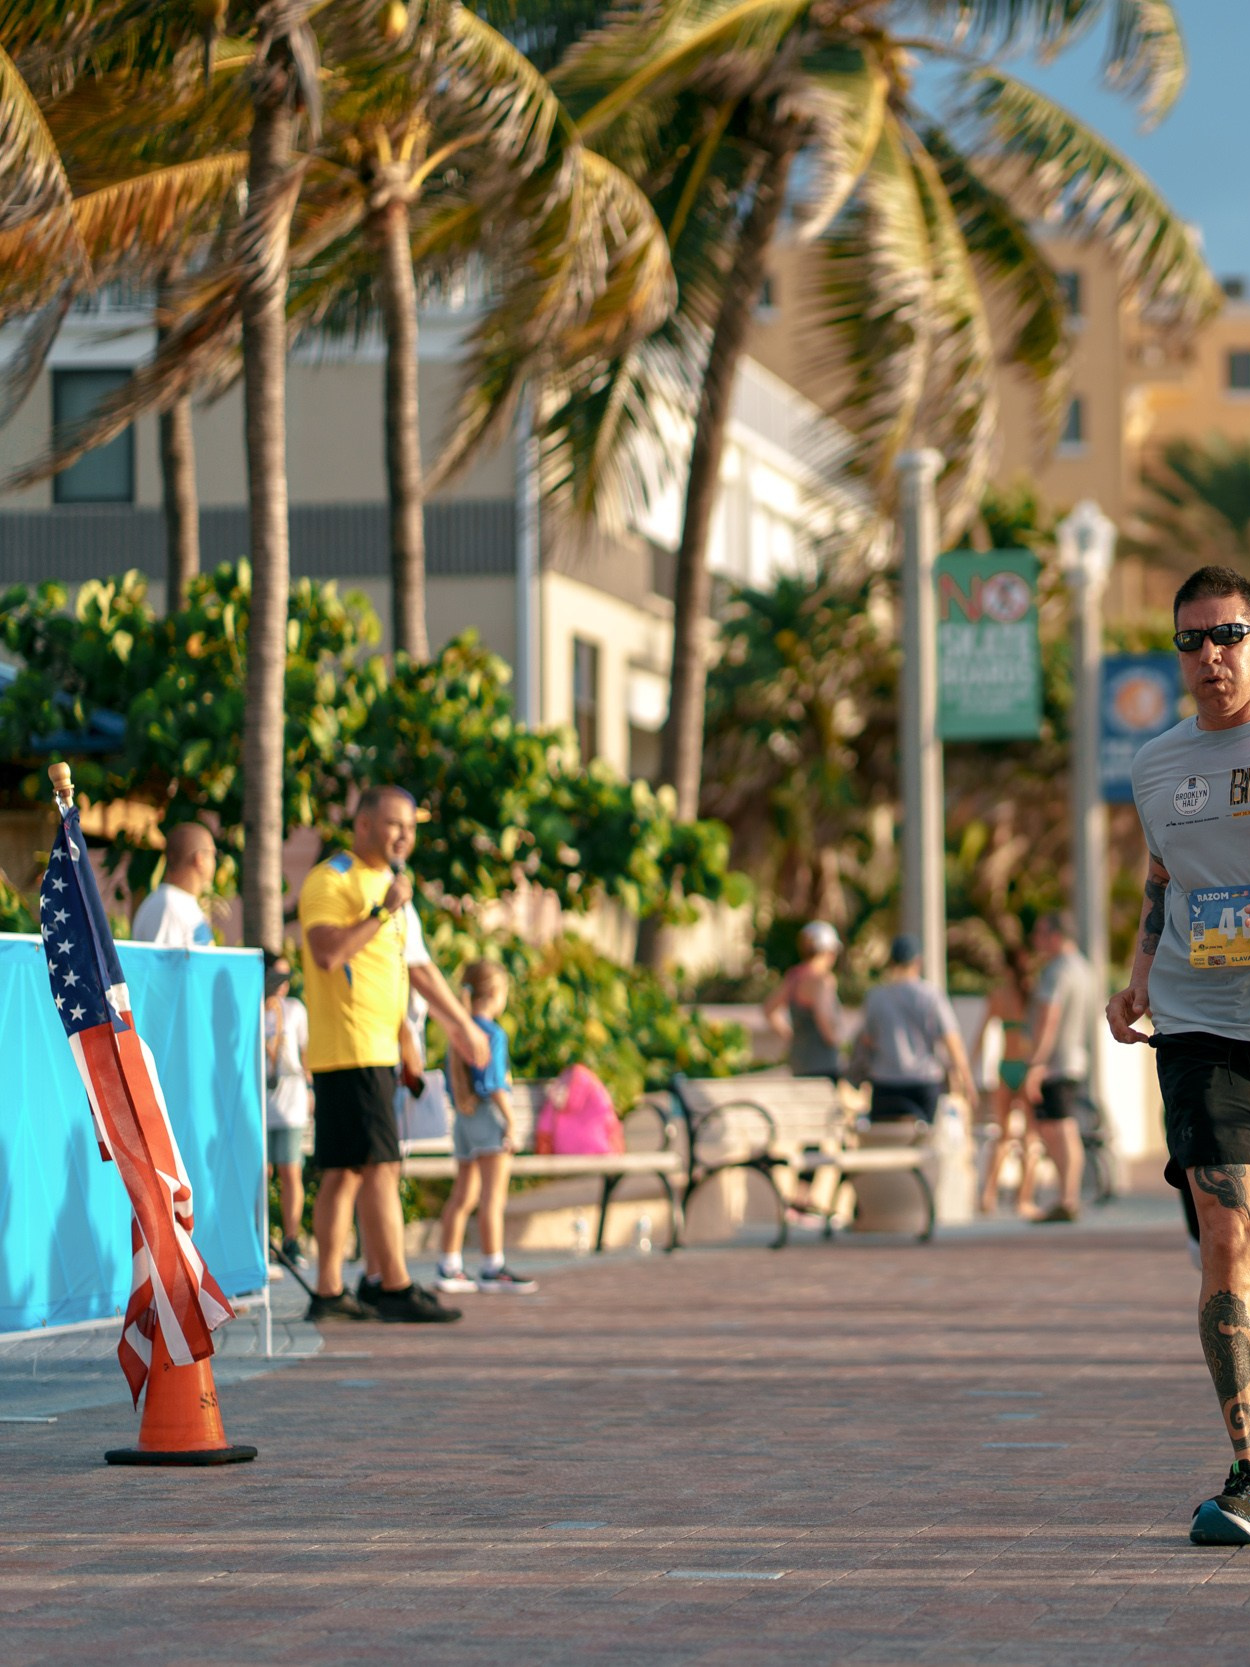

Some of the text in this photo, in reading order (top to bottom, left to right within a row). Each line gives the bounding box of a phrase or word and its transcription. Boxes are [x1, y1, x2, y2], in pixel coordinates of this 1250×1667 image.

[1175, 789, 1208, 801] BROOKLYN
[1182, 798, 1198, 808] HALF
[1197, 891, 1229, 903] RAZOM
